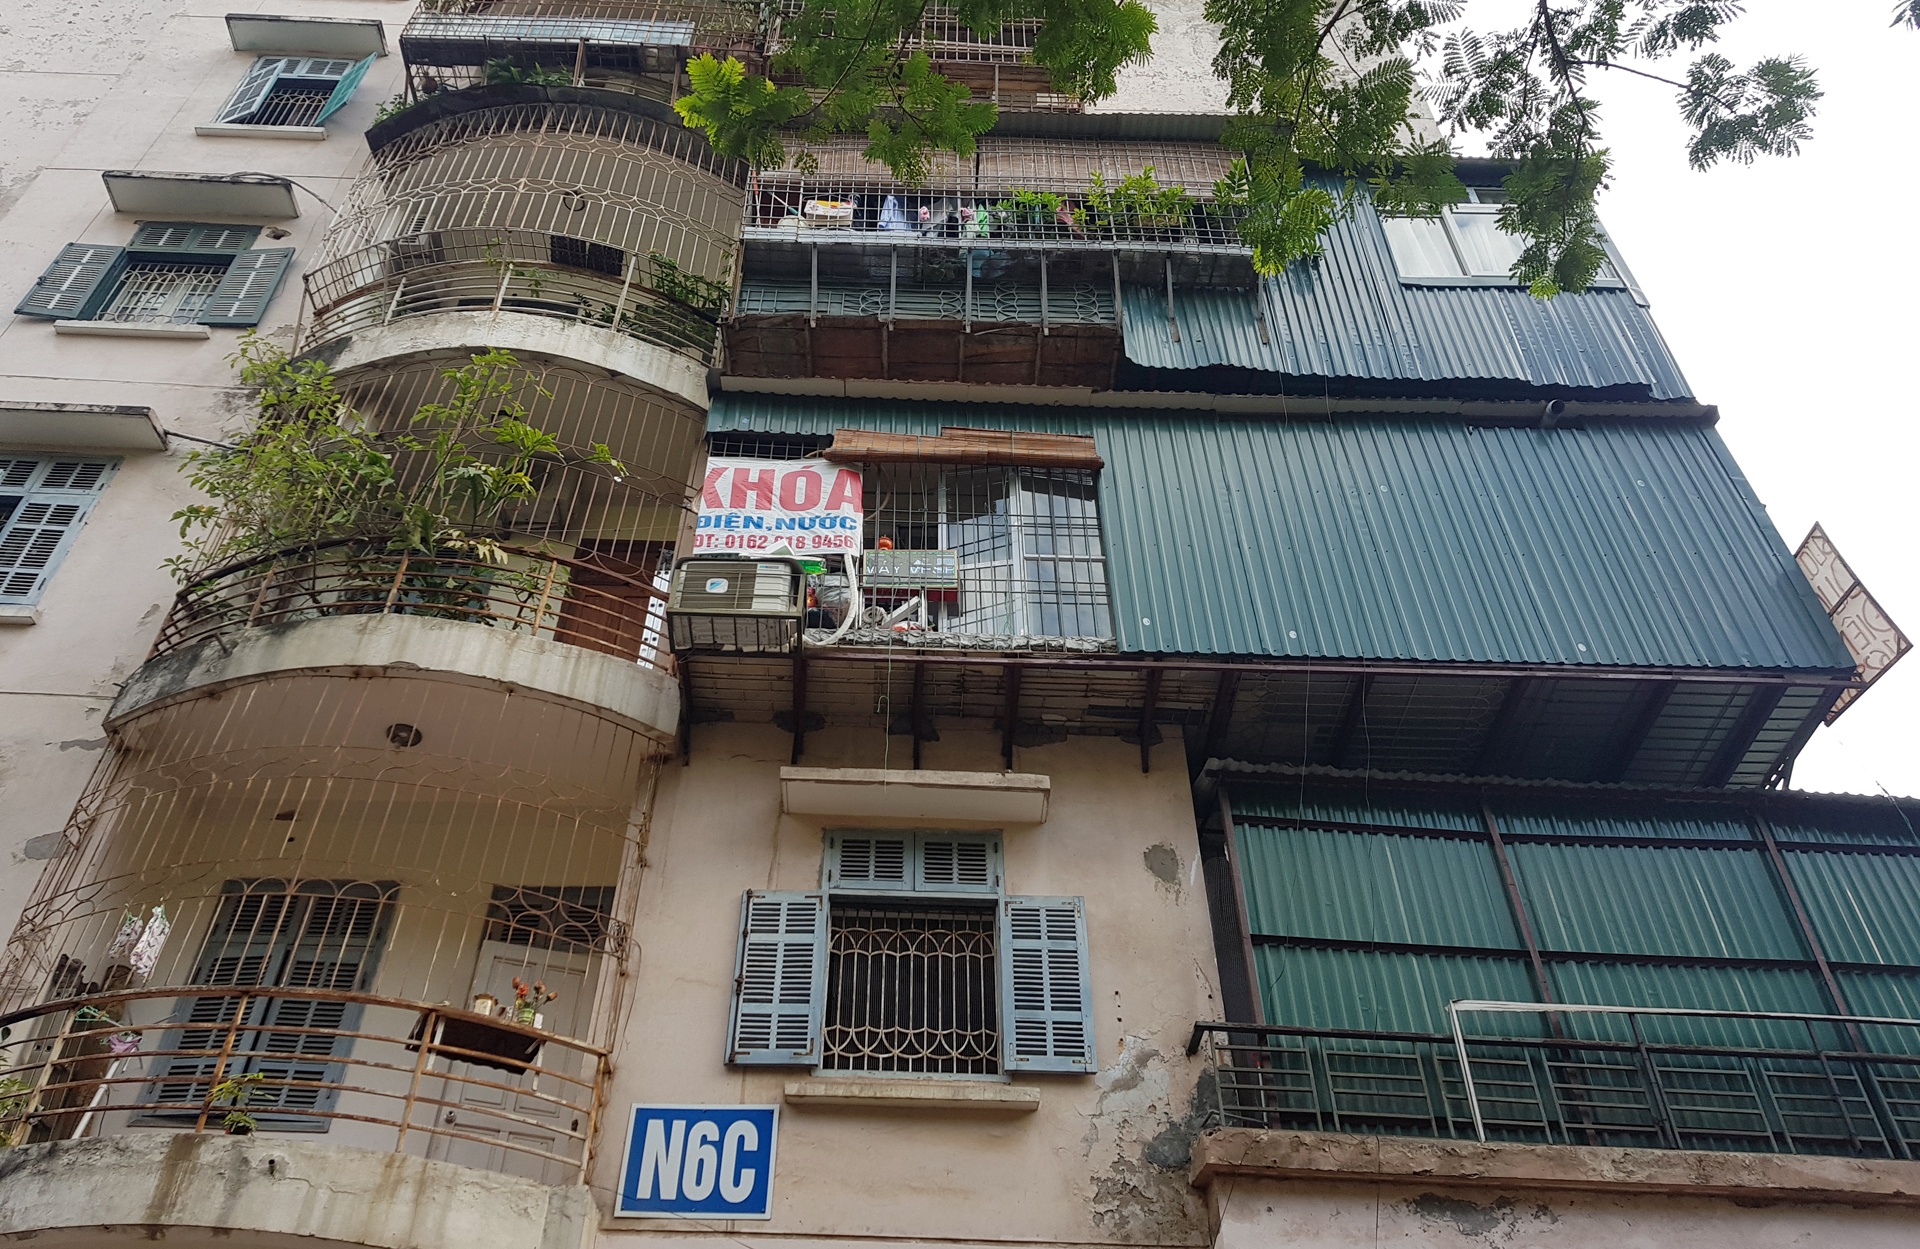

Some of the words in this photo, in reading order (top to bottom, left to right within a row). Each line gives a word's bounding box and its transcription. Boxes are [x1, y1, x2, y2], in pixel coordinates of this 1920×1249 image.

[703, 465, 863, 514] KHÓA
[725, 534, 768, 549] 0162
[811, 535, 854, 549] 9456
[636, 1119, 759, 1204] N6C
